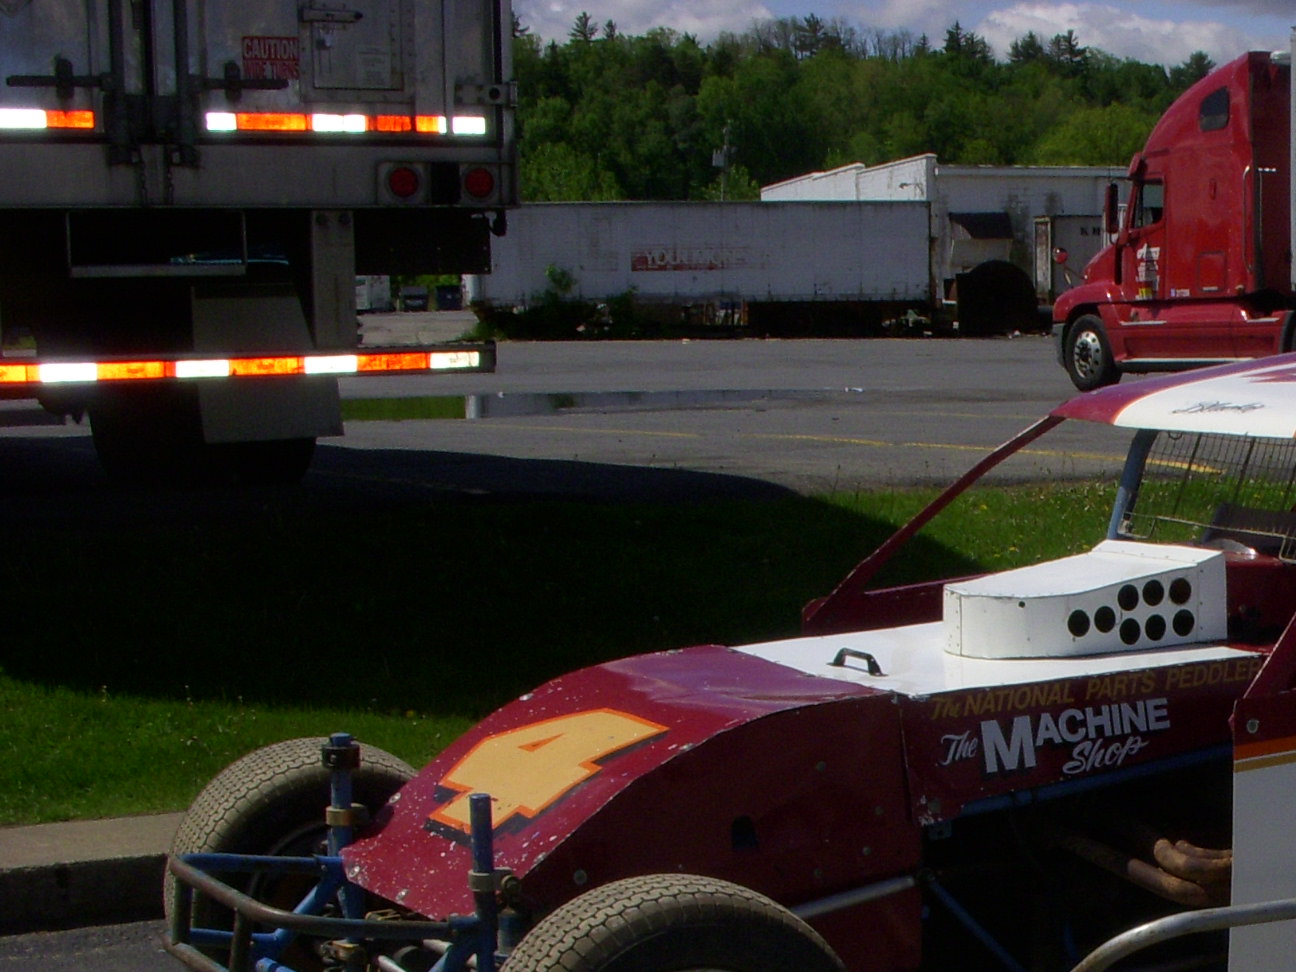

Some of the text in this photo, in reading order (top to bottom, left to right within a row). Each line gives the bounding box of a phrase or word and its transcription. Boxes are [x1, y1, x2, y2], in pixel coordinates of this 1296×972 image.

[242, 38, 299, 60] CAUTION
[962, 681, 1075, 717] NATIONAL
[1085, 669, 1156, 701] PARTS
[937, 729, 980, 768] The
[1062, 734, 1150, 776] Shop
[428, 707, 671, 836] 4
